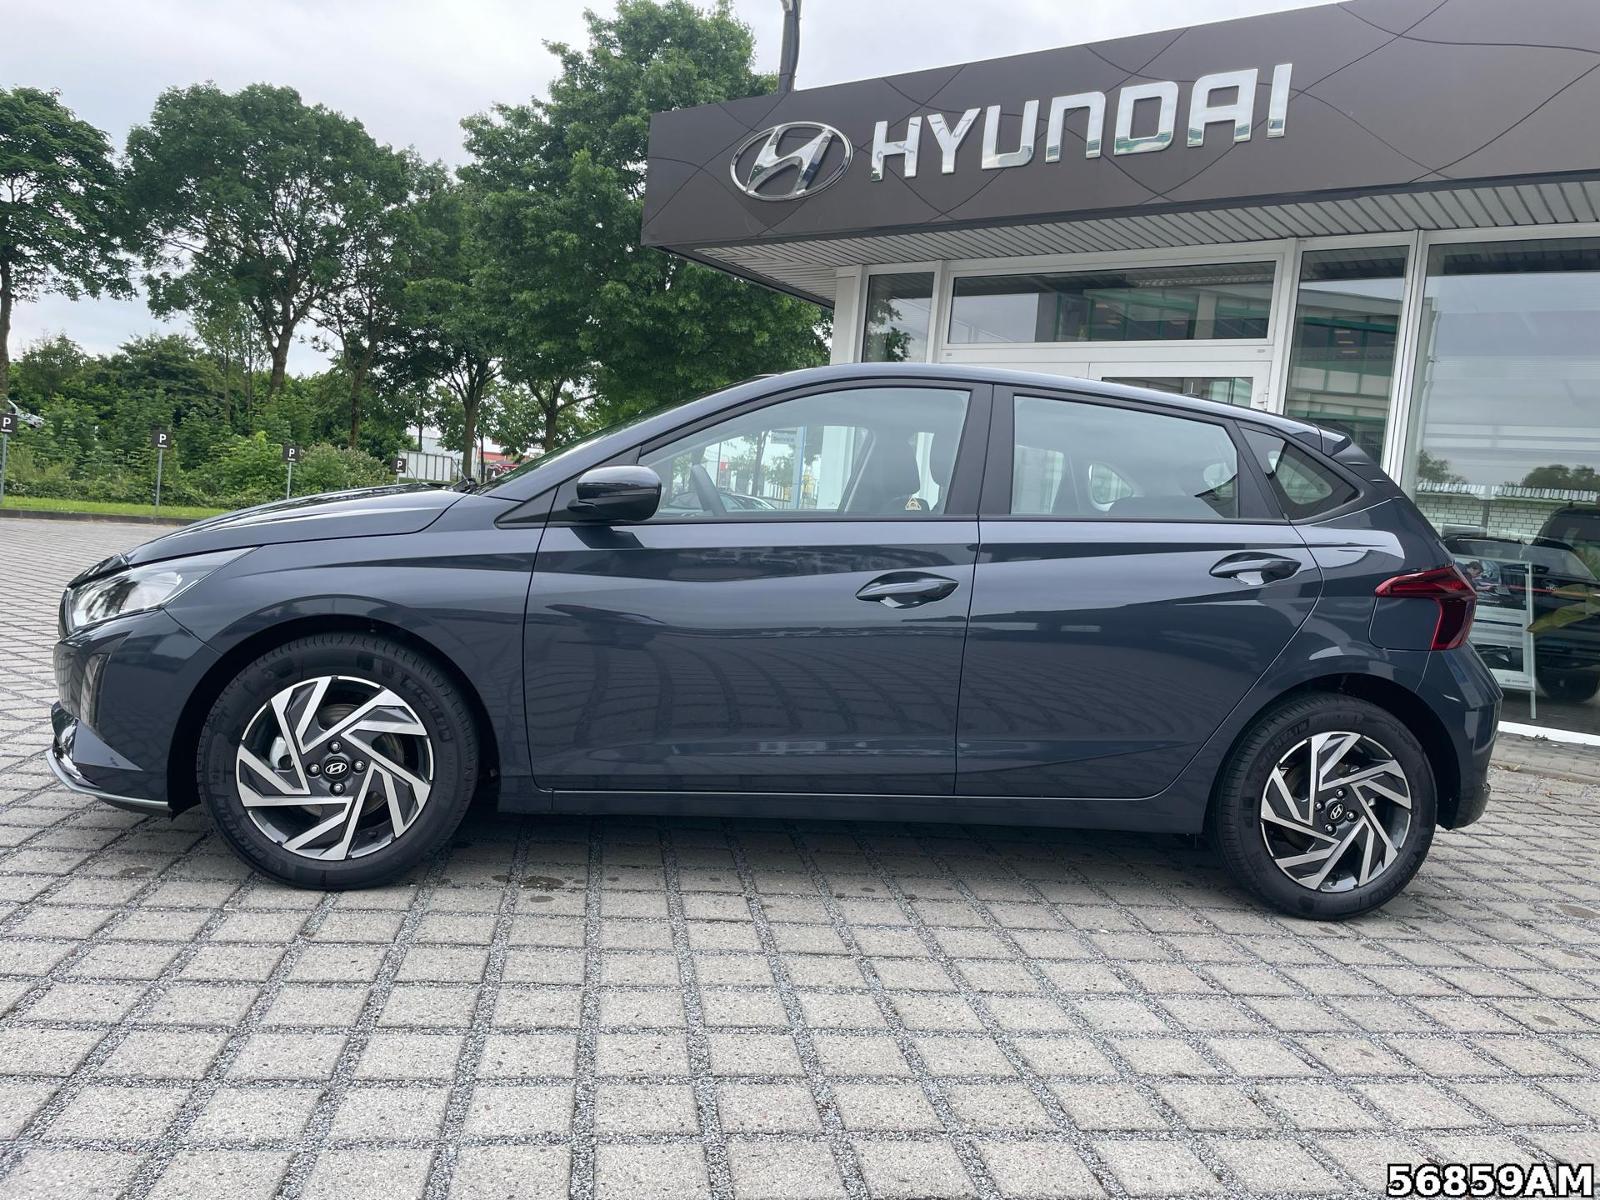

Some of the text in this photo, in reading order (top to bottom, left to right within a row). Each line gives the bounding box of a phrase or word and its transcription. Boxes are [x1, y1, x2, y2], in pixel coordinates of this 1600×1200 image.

[871, 63, 1292, 181] HYUNDAI
[3, 417, 11, 427] P
[159, 433, 166, 443] P
[289, 448, 295, 457] P
[397, 460, 402, 468] P
